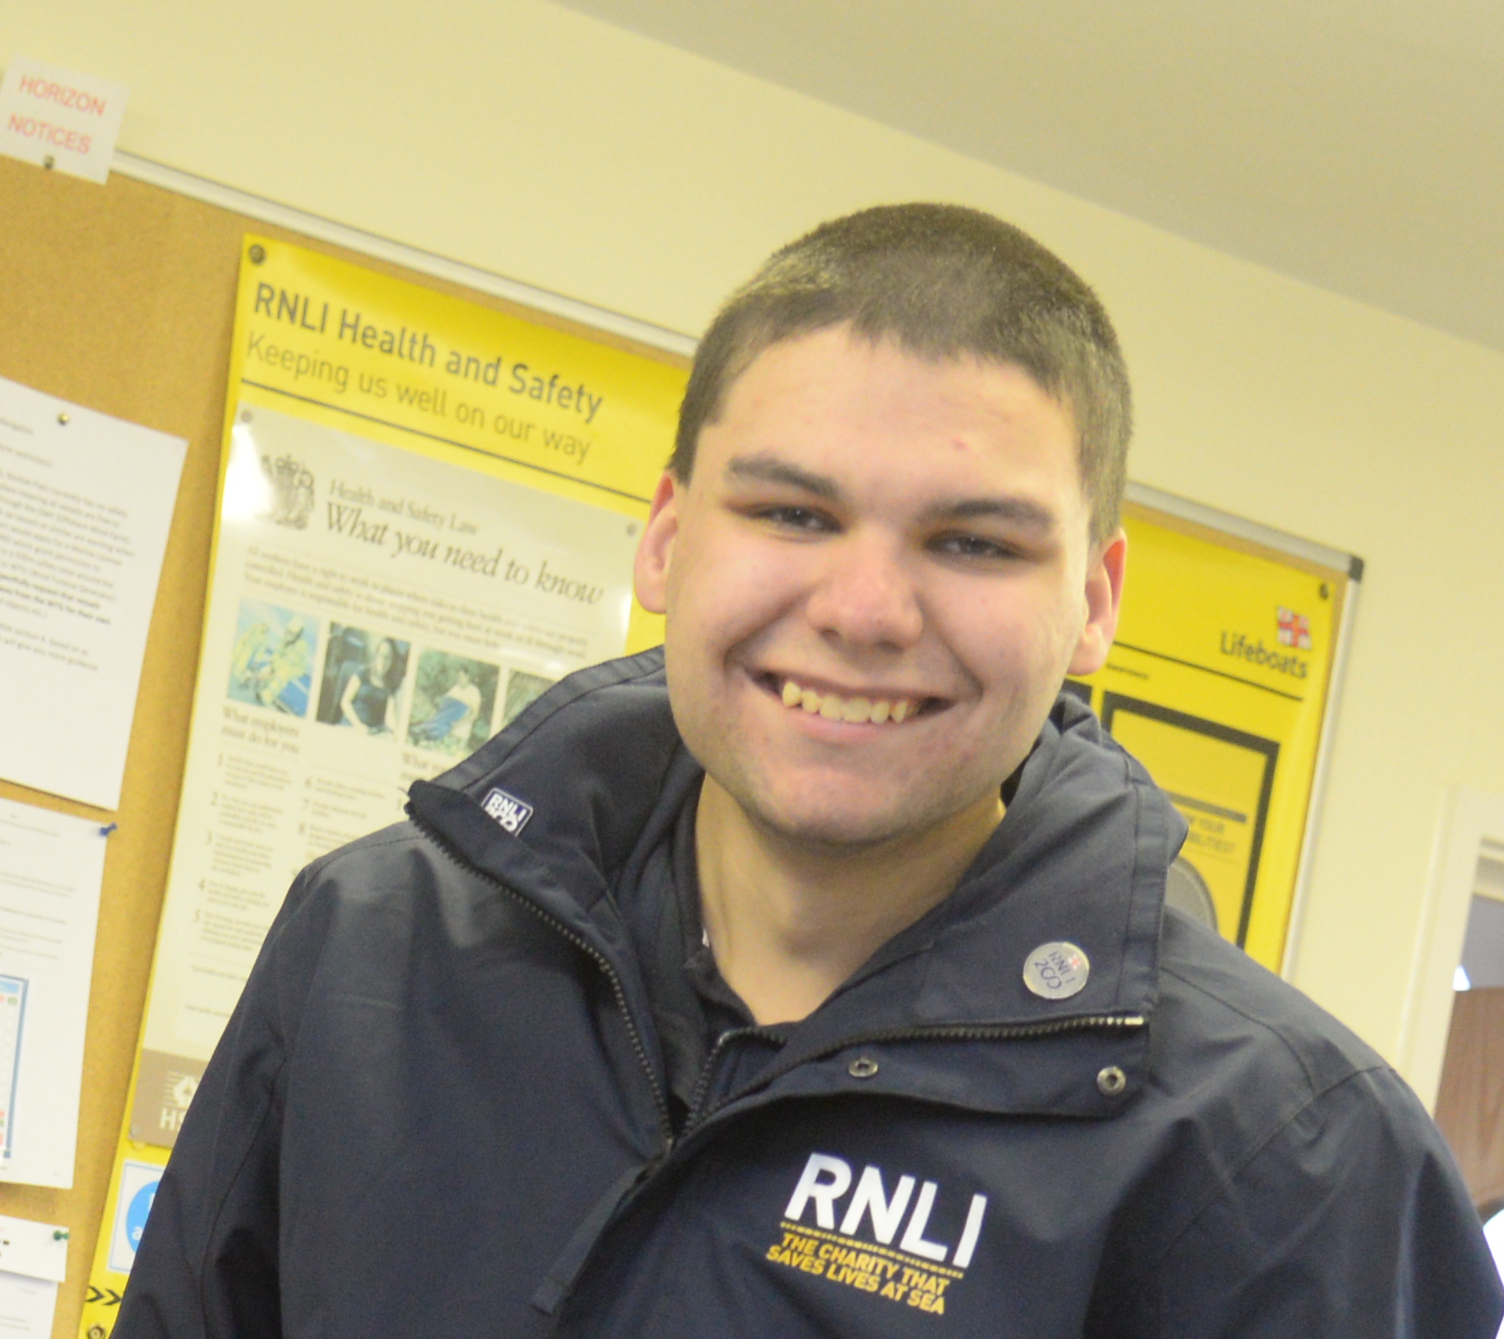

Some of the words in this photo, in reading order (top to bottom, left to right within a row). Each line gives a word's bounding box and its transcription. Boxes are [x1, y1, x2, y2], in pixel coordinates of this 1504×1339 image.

[19, 75, 107, 117] HORIZON
[8, 112, 92, 154] NOTICES
[253, 282, 330, 336] RNLI
[338, 308, 437, 369] Health
[446, 345, 500, 386] and
[511, 363, 604, 424] Safety
[247, 331, 348, 394] Keeping
[358, 366, 388, 398] us
[396, 377, 447, 418] well
[456, 394, 486, 426] on
[494, 406, 534, 445] our
[543, 422, 591, 464] way
[329, 479, 373, 509] Health
[377, 491, 405, 516] and
[407, 500, 446, 531] Safety
[451, 510, 479, 536] Law
[324, 501, 388, 547] What
[394, 523, 440, 560] you
[443, 535, 498, 578] need
[505, 551, 530, 582] to
[537, 558, 604, 606] know
[1220, 631, 1309, 681] Lifeboats
[489, 793, 527, 822] RNLI
[784, 1152, 988, 1268] RNLI
[765, 1245, 824, 1276] SAVES
[827, 1261, 880, 1294] LIVES
[880, 1282, 907, 1302] AT
[907, 1290, 945, 1315] SEA
[782, 1232, 816, 1257] THE
[818, 1243, 900, 1280] CHARITY
[902, 1266, 949, 1297] THAT
